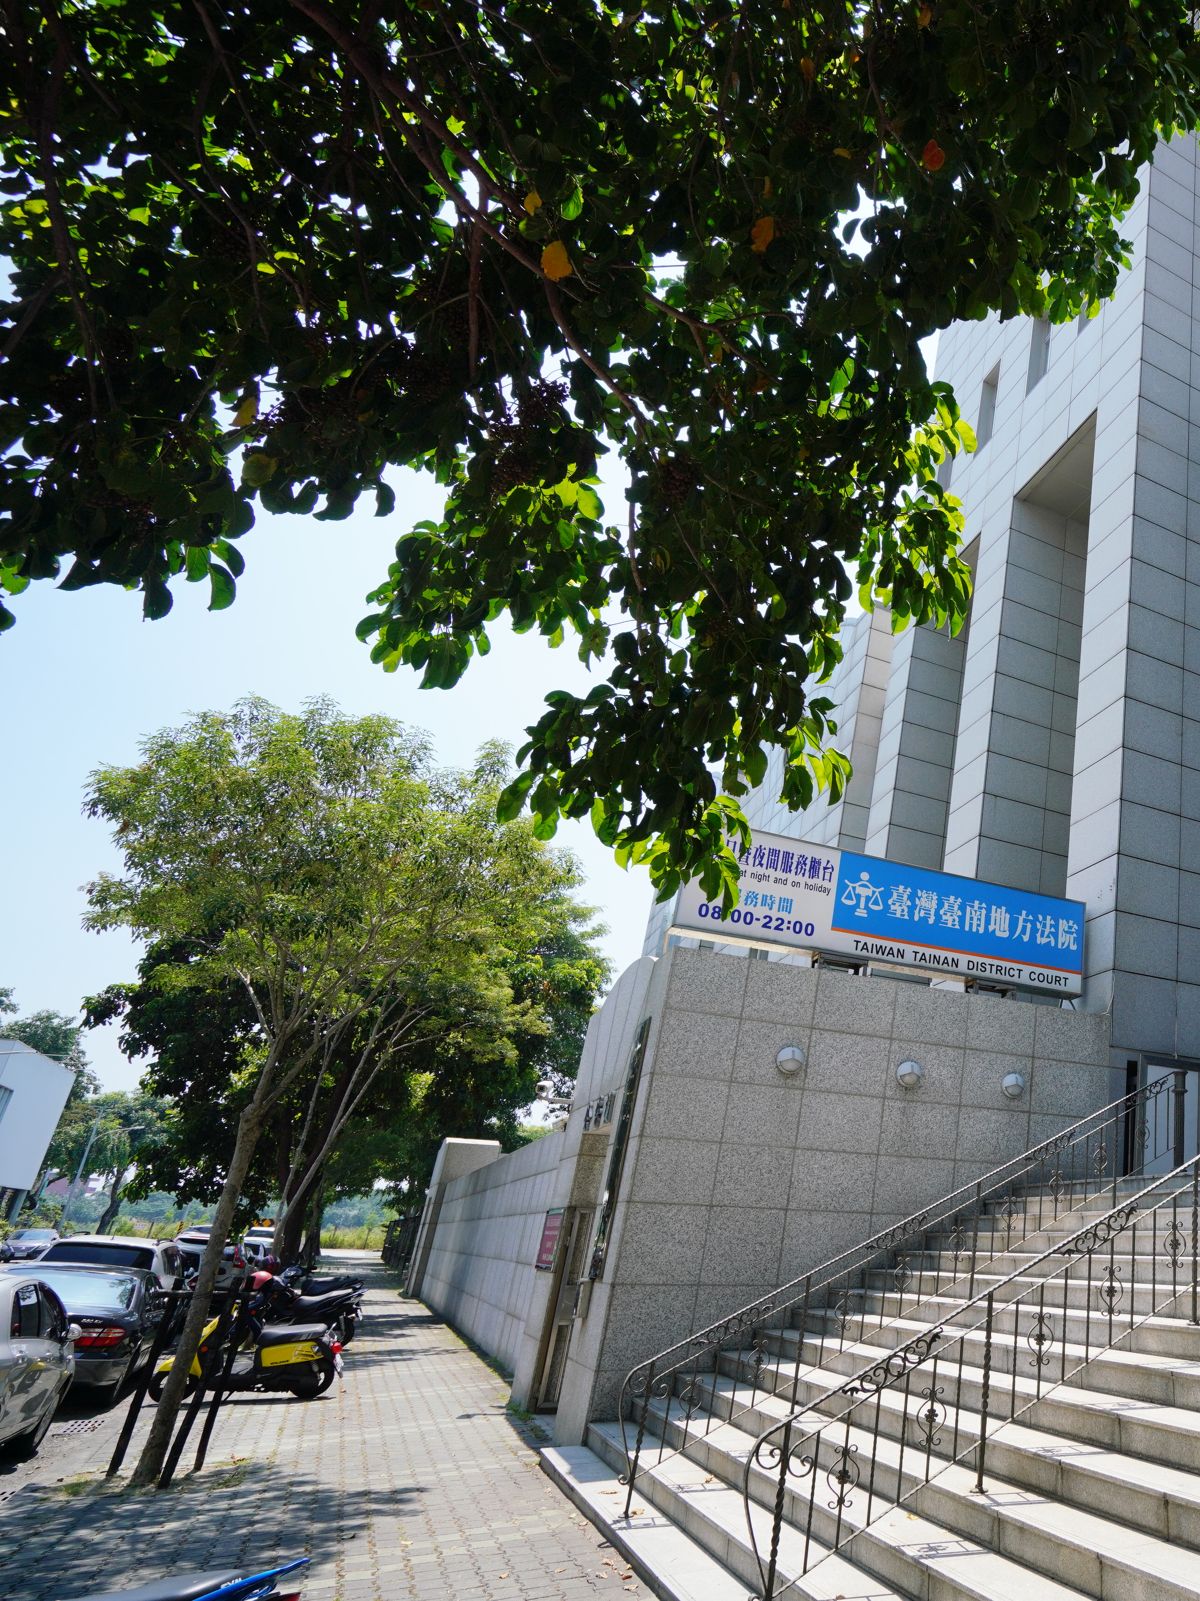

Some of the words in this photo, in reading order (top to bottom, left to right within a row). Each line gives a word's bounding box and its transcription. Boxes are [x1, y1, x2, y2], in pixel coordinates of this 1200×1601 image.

[750, 871, 770, 883] night
[773, 876, 788, 886] and
[791, 880, 801, 888] on
[804, 883, 832, 896] holiday
[738, 889, 794, 915] 務時間
[886, 885, 1078, 951] 臺灣臺南地方法院
[698, 903, 815, 937] 0800-22:00
[853, 939, 905, 960] TAIWAN
[912, 950, 960, 969] TAINAN
[967, 960, 1024, 979] DISTRICT
[1028, 971, 1069, 988] COURT
